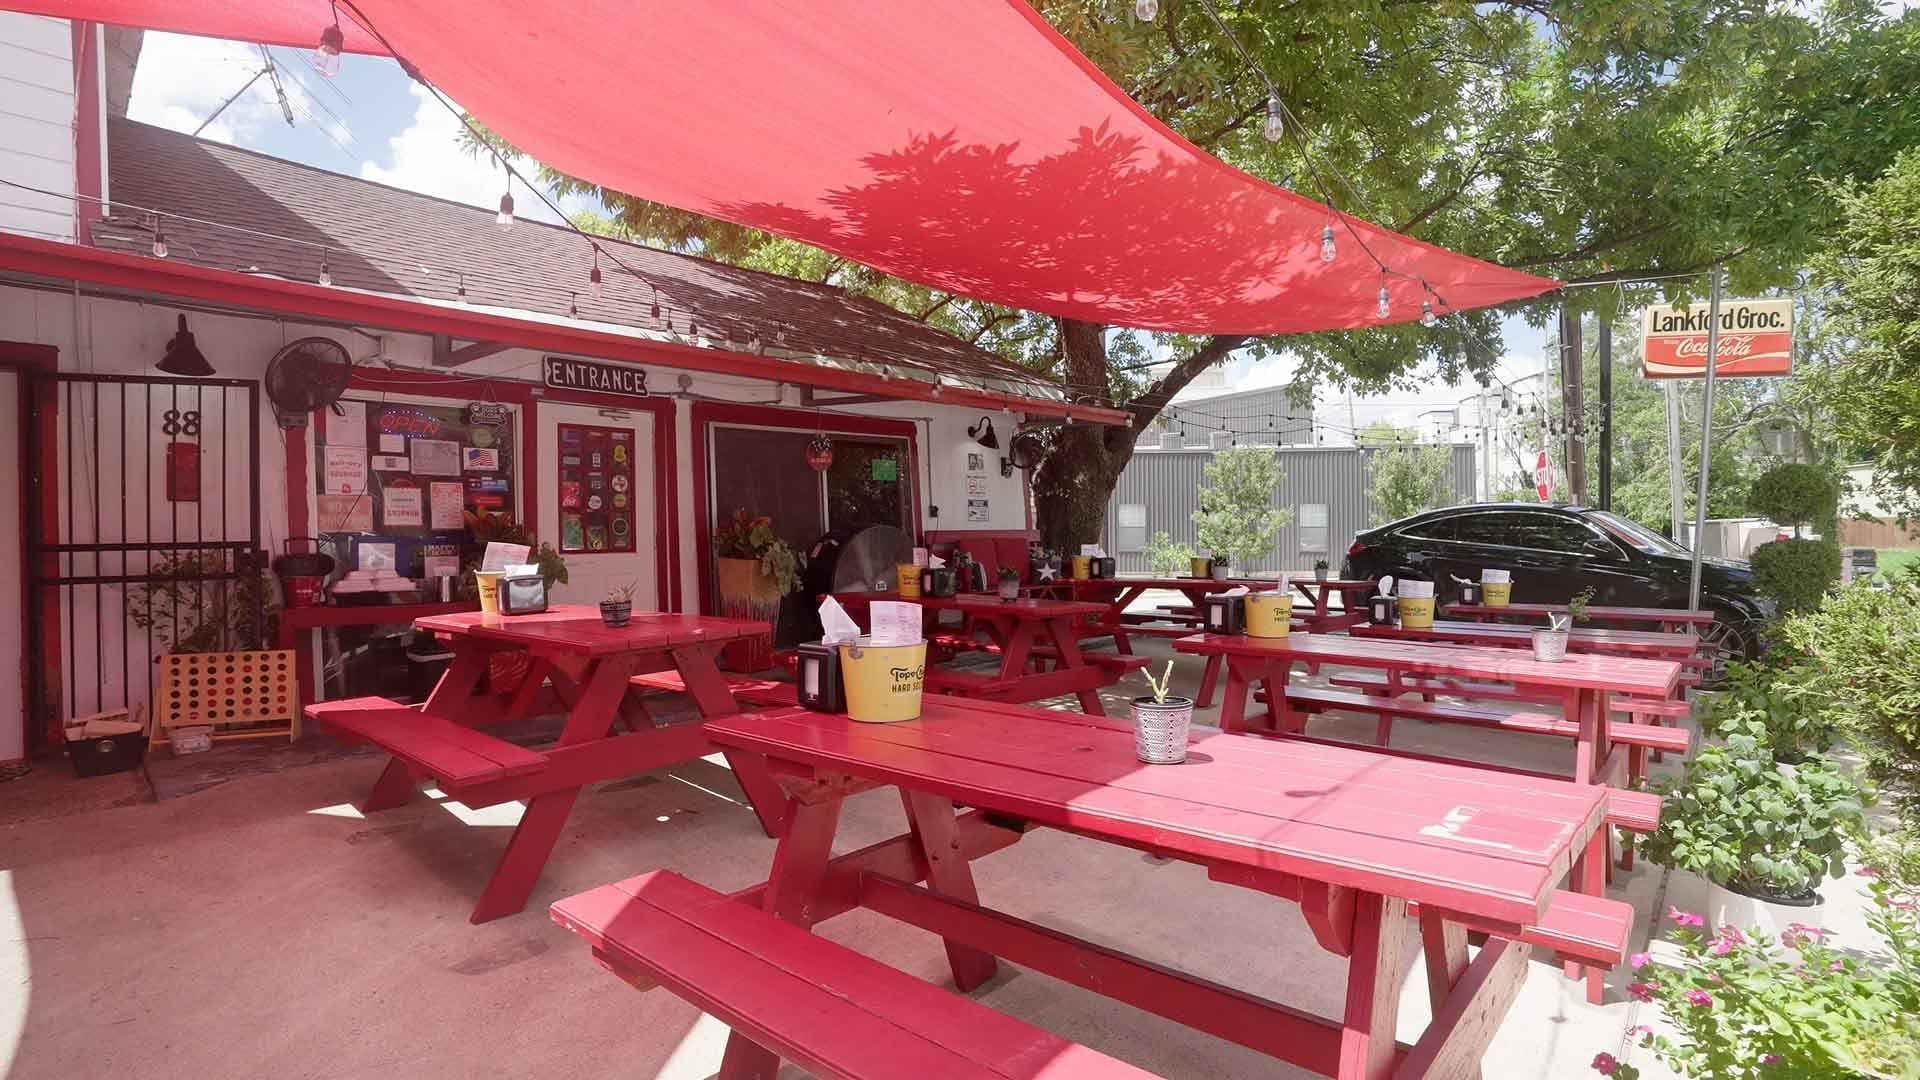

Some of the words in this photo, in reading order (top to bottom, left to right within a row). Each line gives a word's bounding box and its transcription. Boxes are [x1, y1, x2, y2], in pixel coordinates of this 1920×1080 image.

[1652, 308, 1734, 332] Lankfod
[1737, 306, 1785, 329] Groc.
[1675, 335, 1756, 358] CocaCola
[552, 361, 645, 393] ENTRANCE
[162, 409, 201, 435] 88
[890, 667, 915, 682] Topo
[892, 683, 911, 693] HARD
